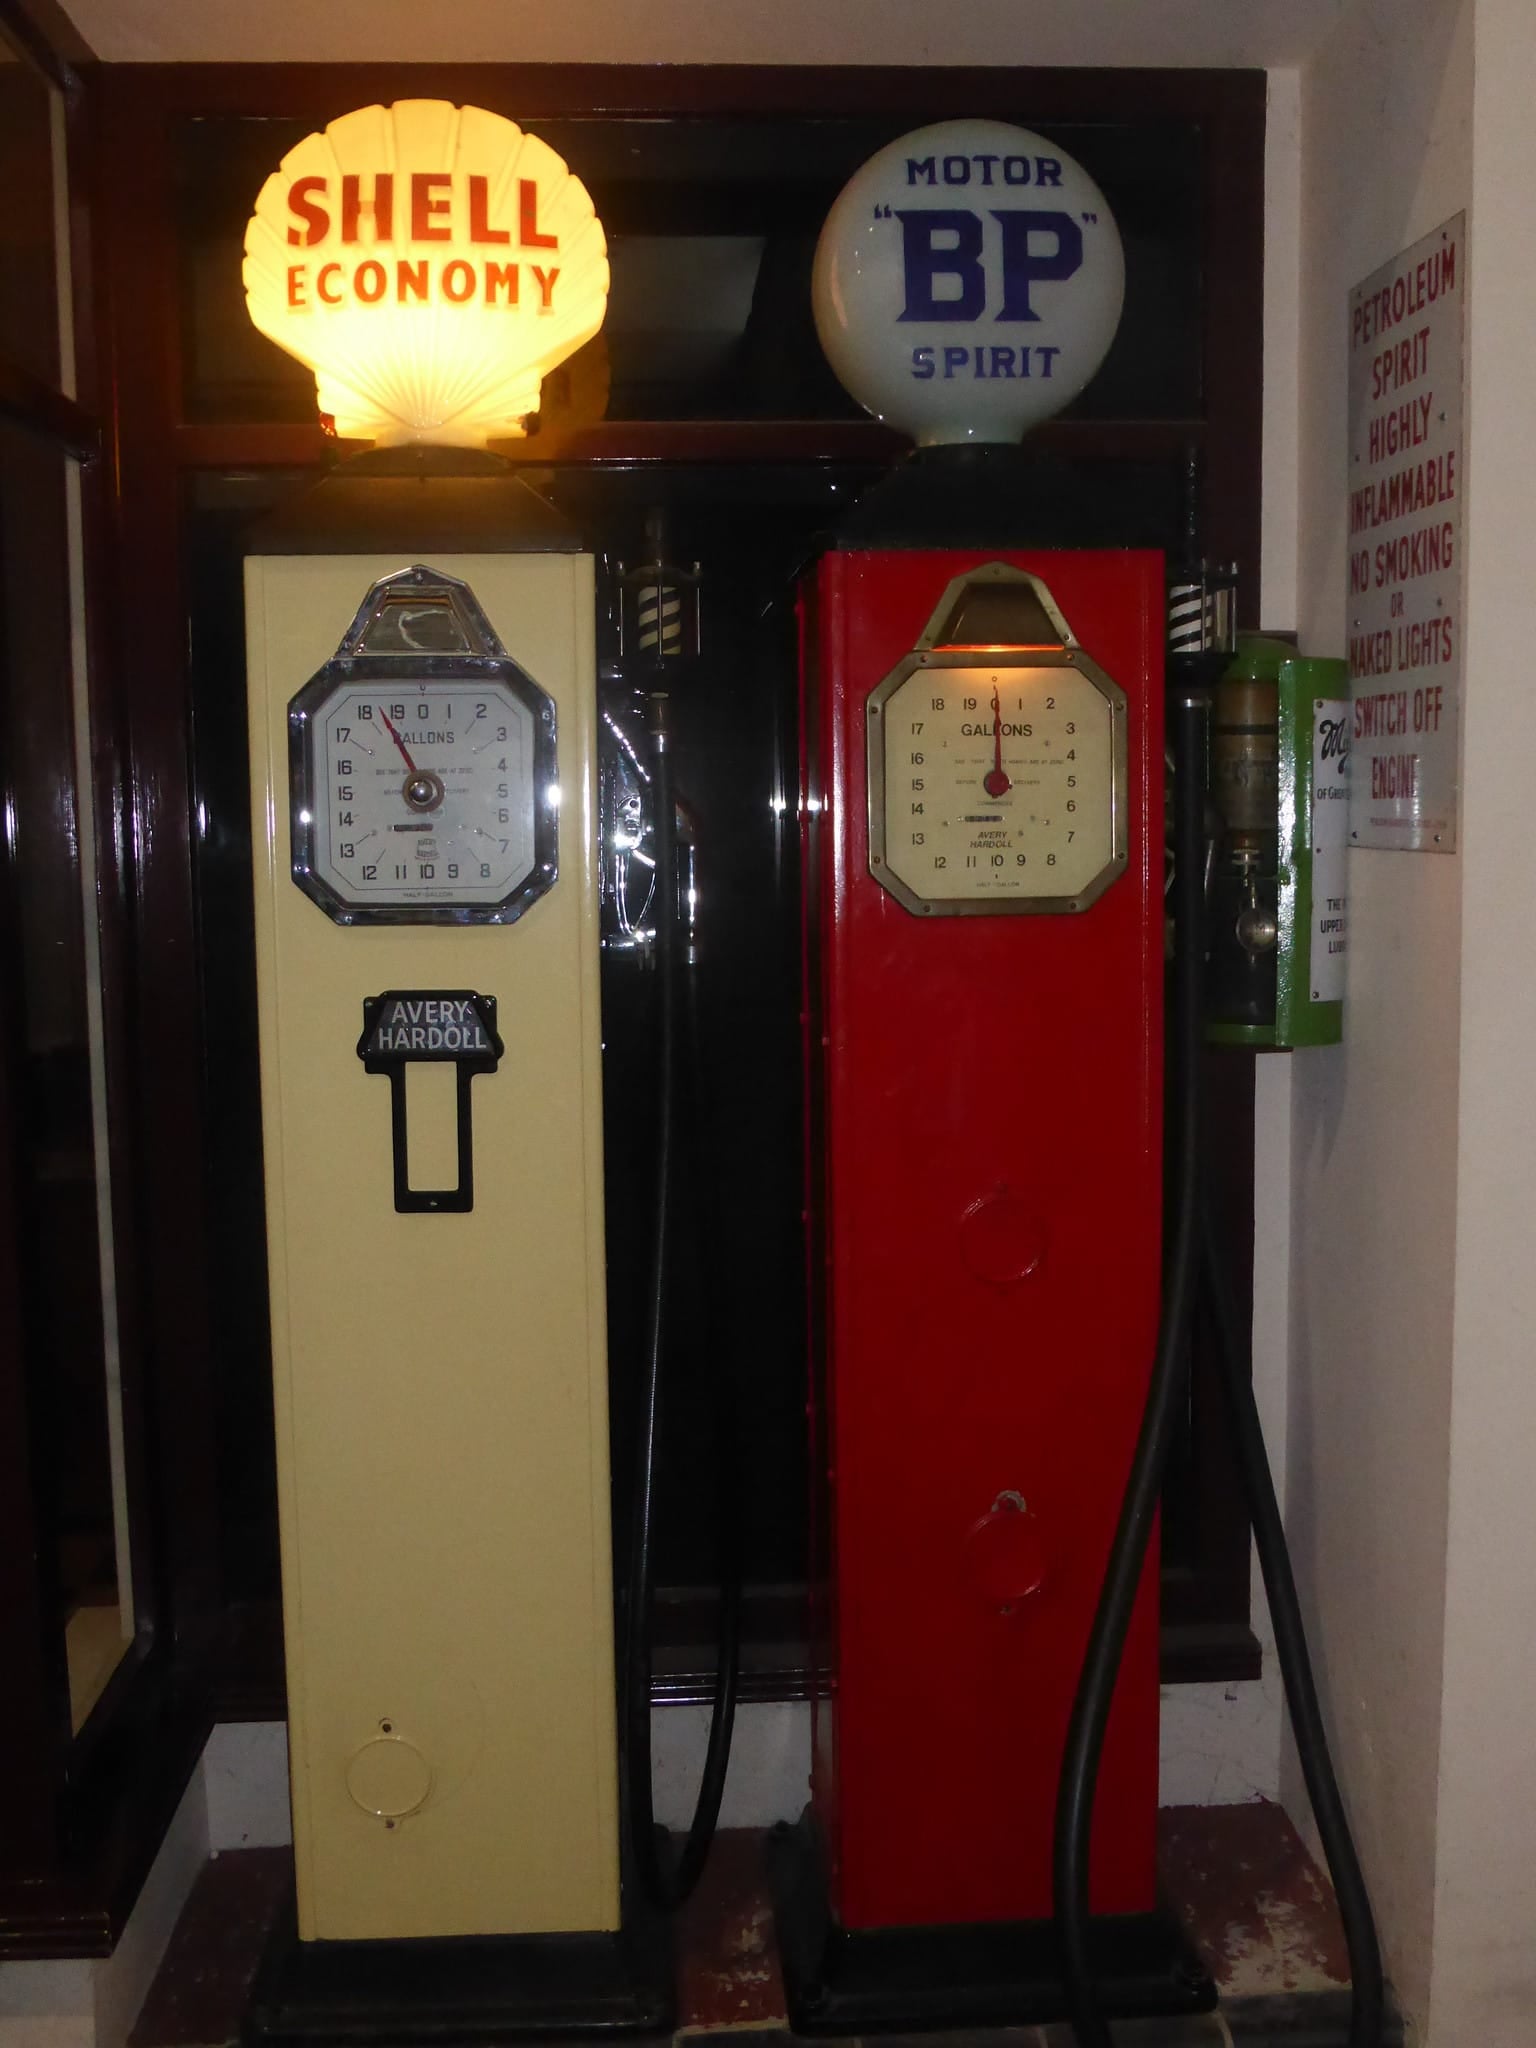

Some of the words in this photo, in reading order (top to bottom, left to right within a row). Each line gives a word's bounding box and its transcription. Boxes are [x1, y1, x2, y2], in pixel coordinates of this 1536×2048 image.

[906, 155, 1063, 186] MOTOR
[287, 173, 558, 249] SHELL
[287, 259, 560, 309] ECONOMY
[1353, 242, 1455, 350] PETROLEUM
[911, 347, 1061, 379] SPIRIT
[1372, 326, 1430, 400] SPIRIT
[1369, 391, 1433, 464] HIGHLY
[1351, 451, 1454, 534] INFLAMMABLE
[1351, 550, 1370, 594] NO
[1375, 522, 1453, 588] SMOKING
[1391, 592, 1404, 618] OR
[1351, 630, 1392, 678] NAKED
[1398, 616, 1452, 671] LIGHTS
[358, 704, 373, 720] 18
[390, 703, 405, 720] 19
[417, 703, 429, 719] 0
[447, 703, 452, 719] 1
[475, 703, 488, 719] 2
[931, 698, 945, 711] 18
[963, 697, 977, 711] 19
[1046, 697, 1056, 710] 2
[1354, 691, 1407, 739] SWITCH
[1413, 686, 1443, 733] OFF
[336, 727, 351, 743] 17
[496, 727, 508, 742] 3
[911, 723, 924, 736] 17
[1065, 722, 1076, 735] 3
[395, 731, 455, 745] ALLONS
[911, 752, 924, 765] 16
[1066, 748, 1076, 761] 4
[337, 760, 353, 775] 16
[497, 758, 508, 772] 4
[1066, 775, 1077, 788] 5
[1372, 754, 1417, 800] ENGINE
[497, 784, 509, 799] 5
[911, 778, 925, 792] 15
[338, 786, 353, 801] 15
[911, 802, 924, 816] 14
[1066, 799, 1077, 813] 6
[338, 812, 354, 826] 14
[498, 810, 509, 824] 6
[912, 831, 925, 846] 13
[977, 831, 1008, 839] AVERY
[1066, 831, 1076, 844] 7
[340, 843, 355, 859] 13
[498, 839, 510, 854] 7
[969, 840, 1014, 849] HARDOLL
[934, 855, 947, 869] 12
[966, 855, 977, 868] 11
[991, 854, 1004, 867] 10
[1016, 853, 1027, 867] 9
[1046, 852, 1057, 866] 8
[362, 865, 378, 880] 12
[395, 864, 407, 880] 11
[420, 863, 435, 879] 10
[447, 863, 459, 879] 9
[480, 863, 492, 878] 8
[1320, 919, 1346, 933] UPPE
[392, 1001, 470, 1024] AVERY
[378, 1026, 487, 1049] HARDOLL
